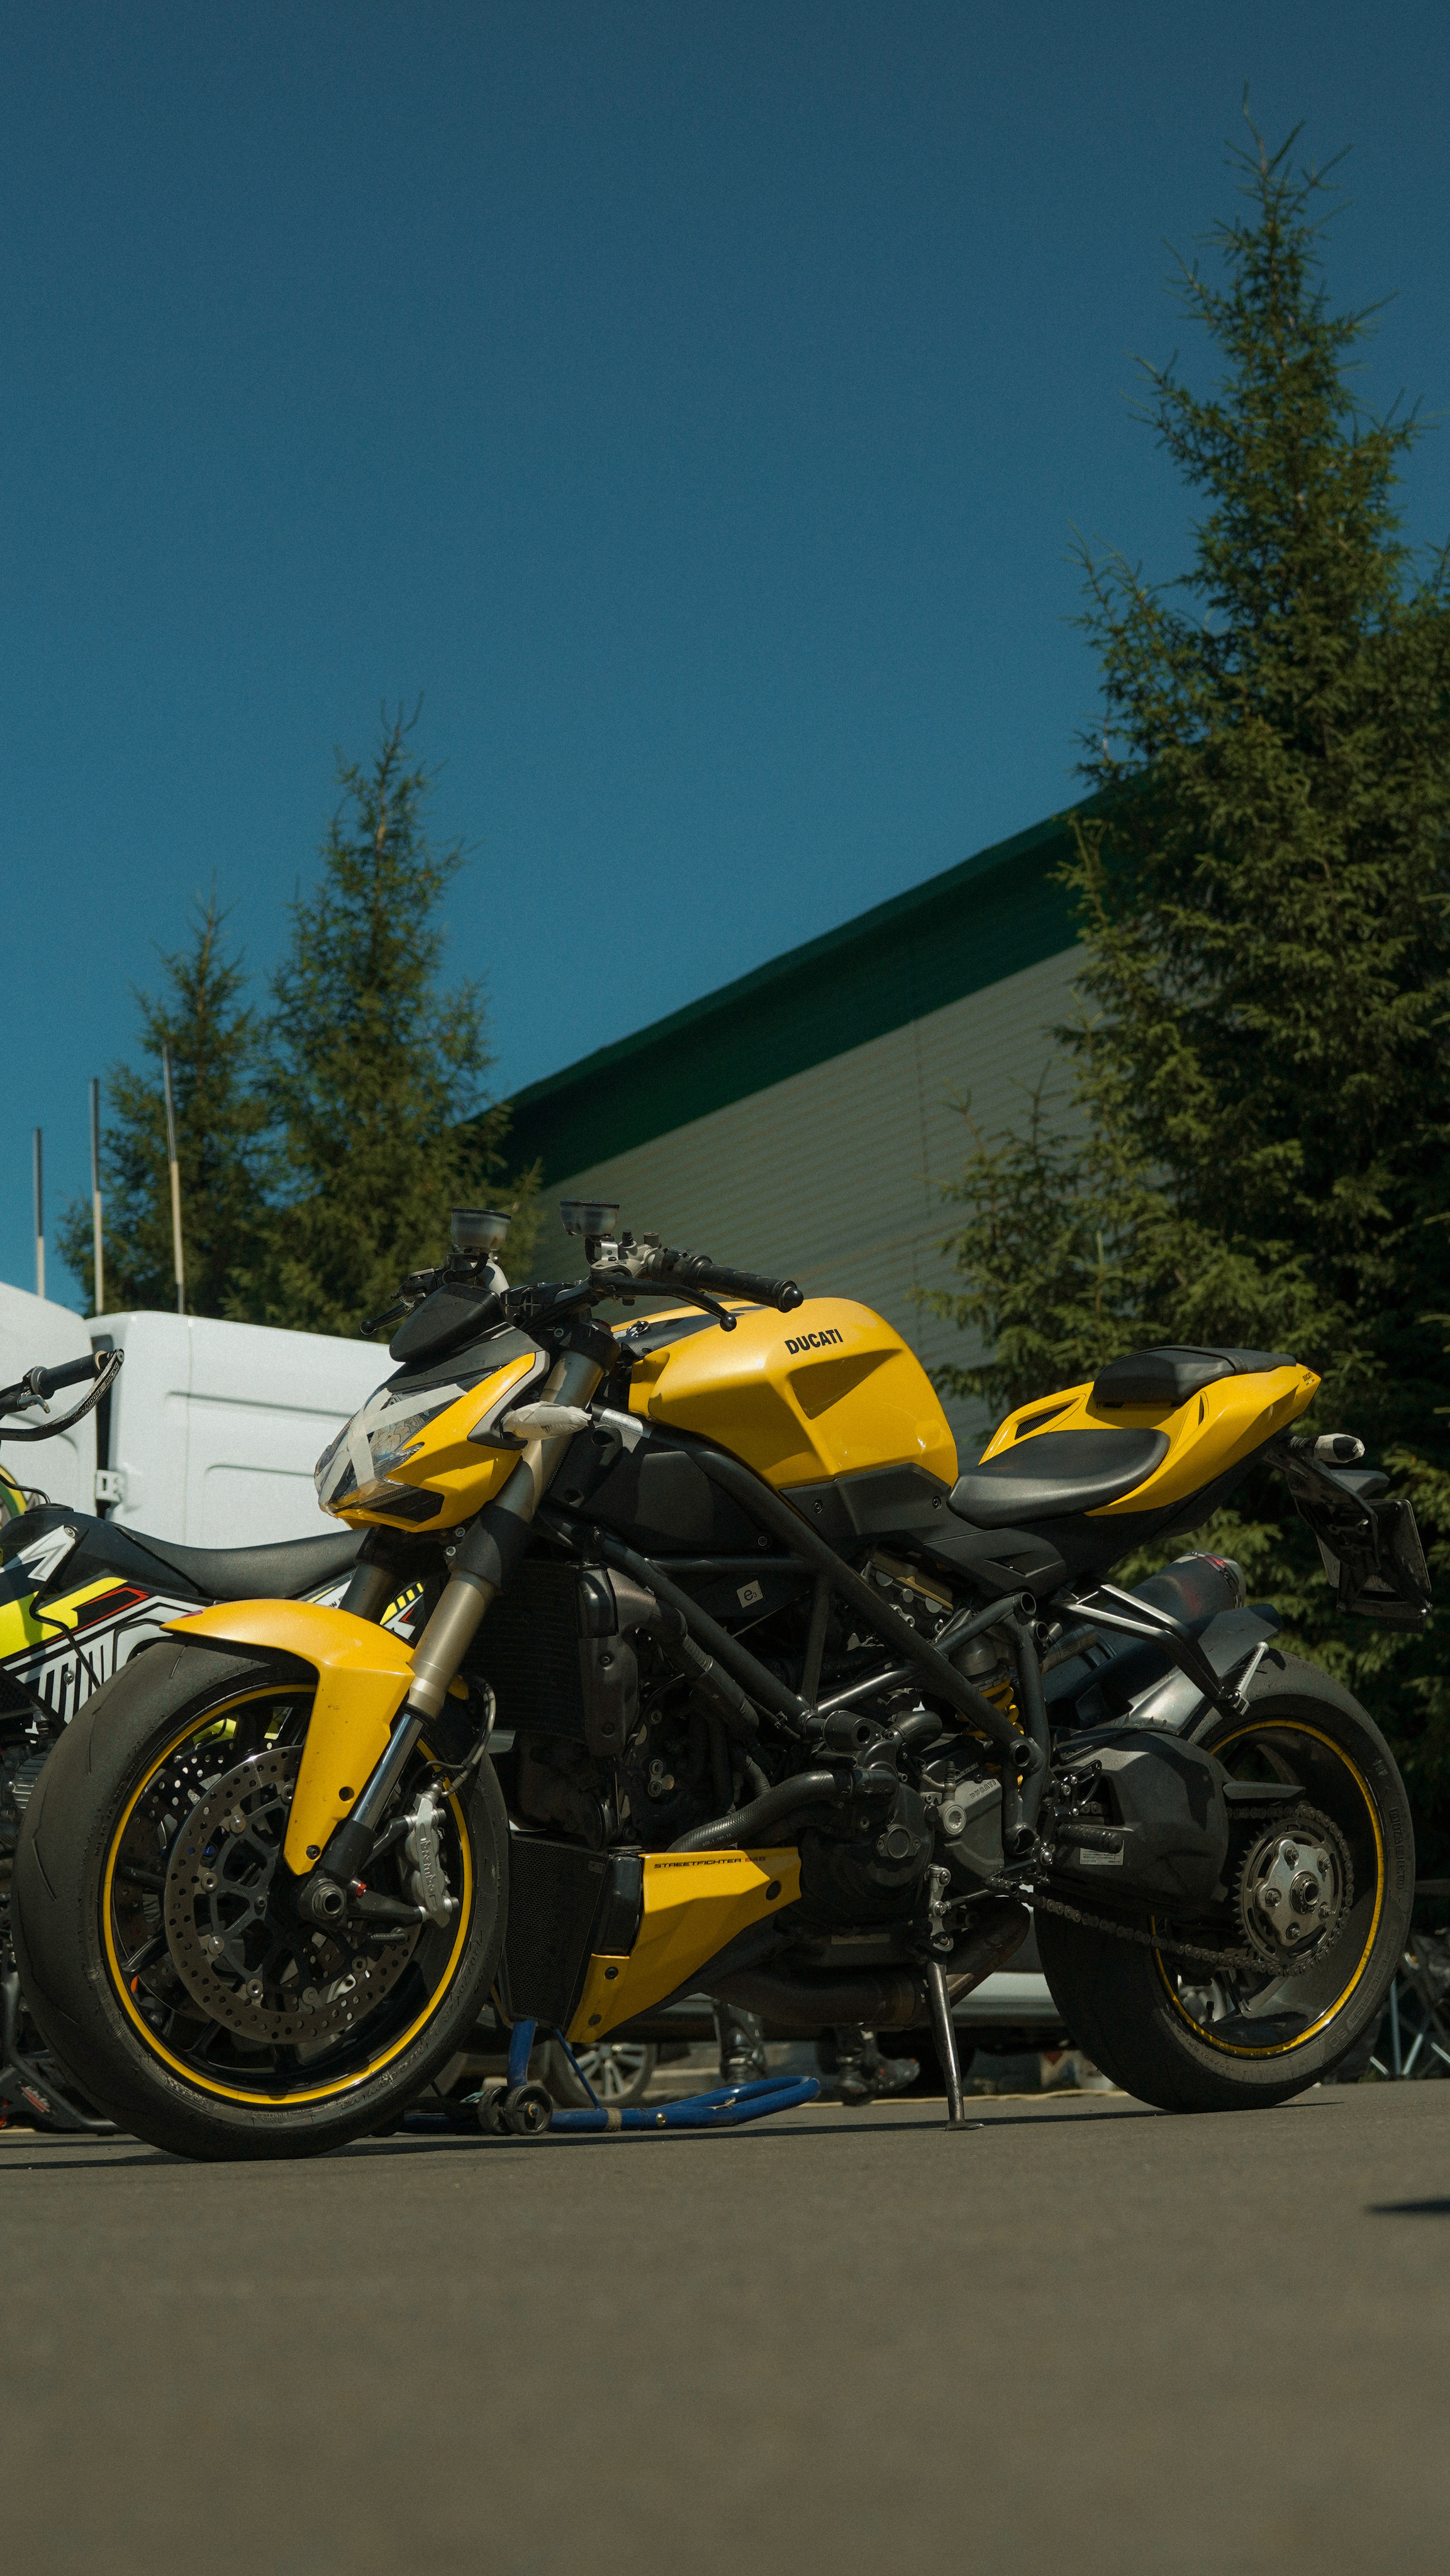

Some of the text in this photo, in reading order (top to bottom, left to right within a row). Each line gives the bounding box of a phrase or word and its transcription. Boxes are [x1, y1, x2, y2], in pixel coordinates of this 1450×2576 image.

[784, 1329, 844, 1355] DUCATI
[85, 1364, 120, 1409] MOOSE RACING
[969, 1779, 996, 1799] DUCATI
[420, 1835, 437, 1894] brembo
[654, 1858, 742, 1868] STREETFIGHTER
[1389, 1806, 1405, 1889] DIABLO
